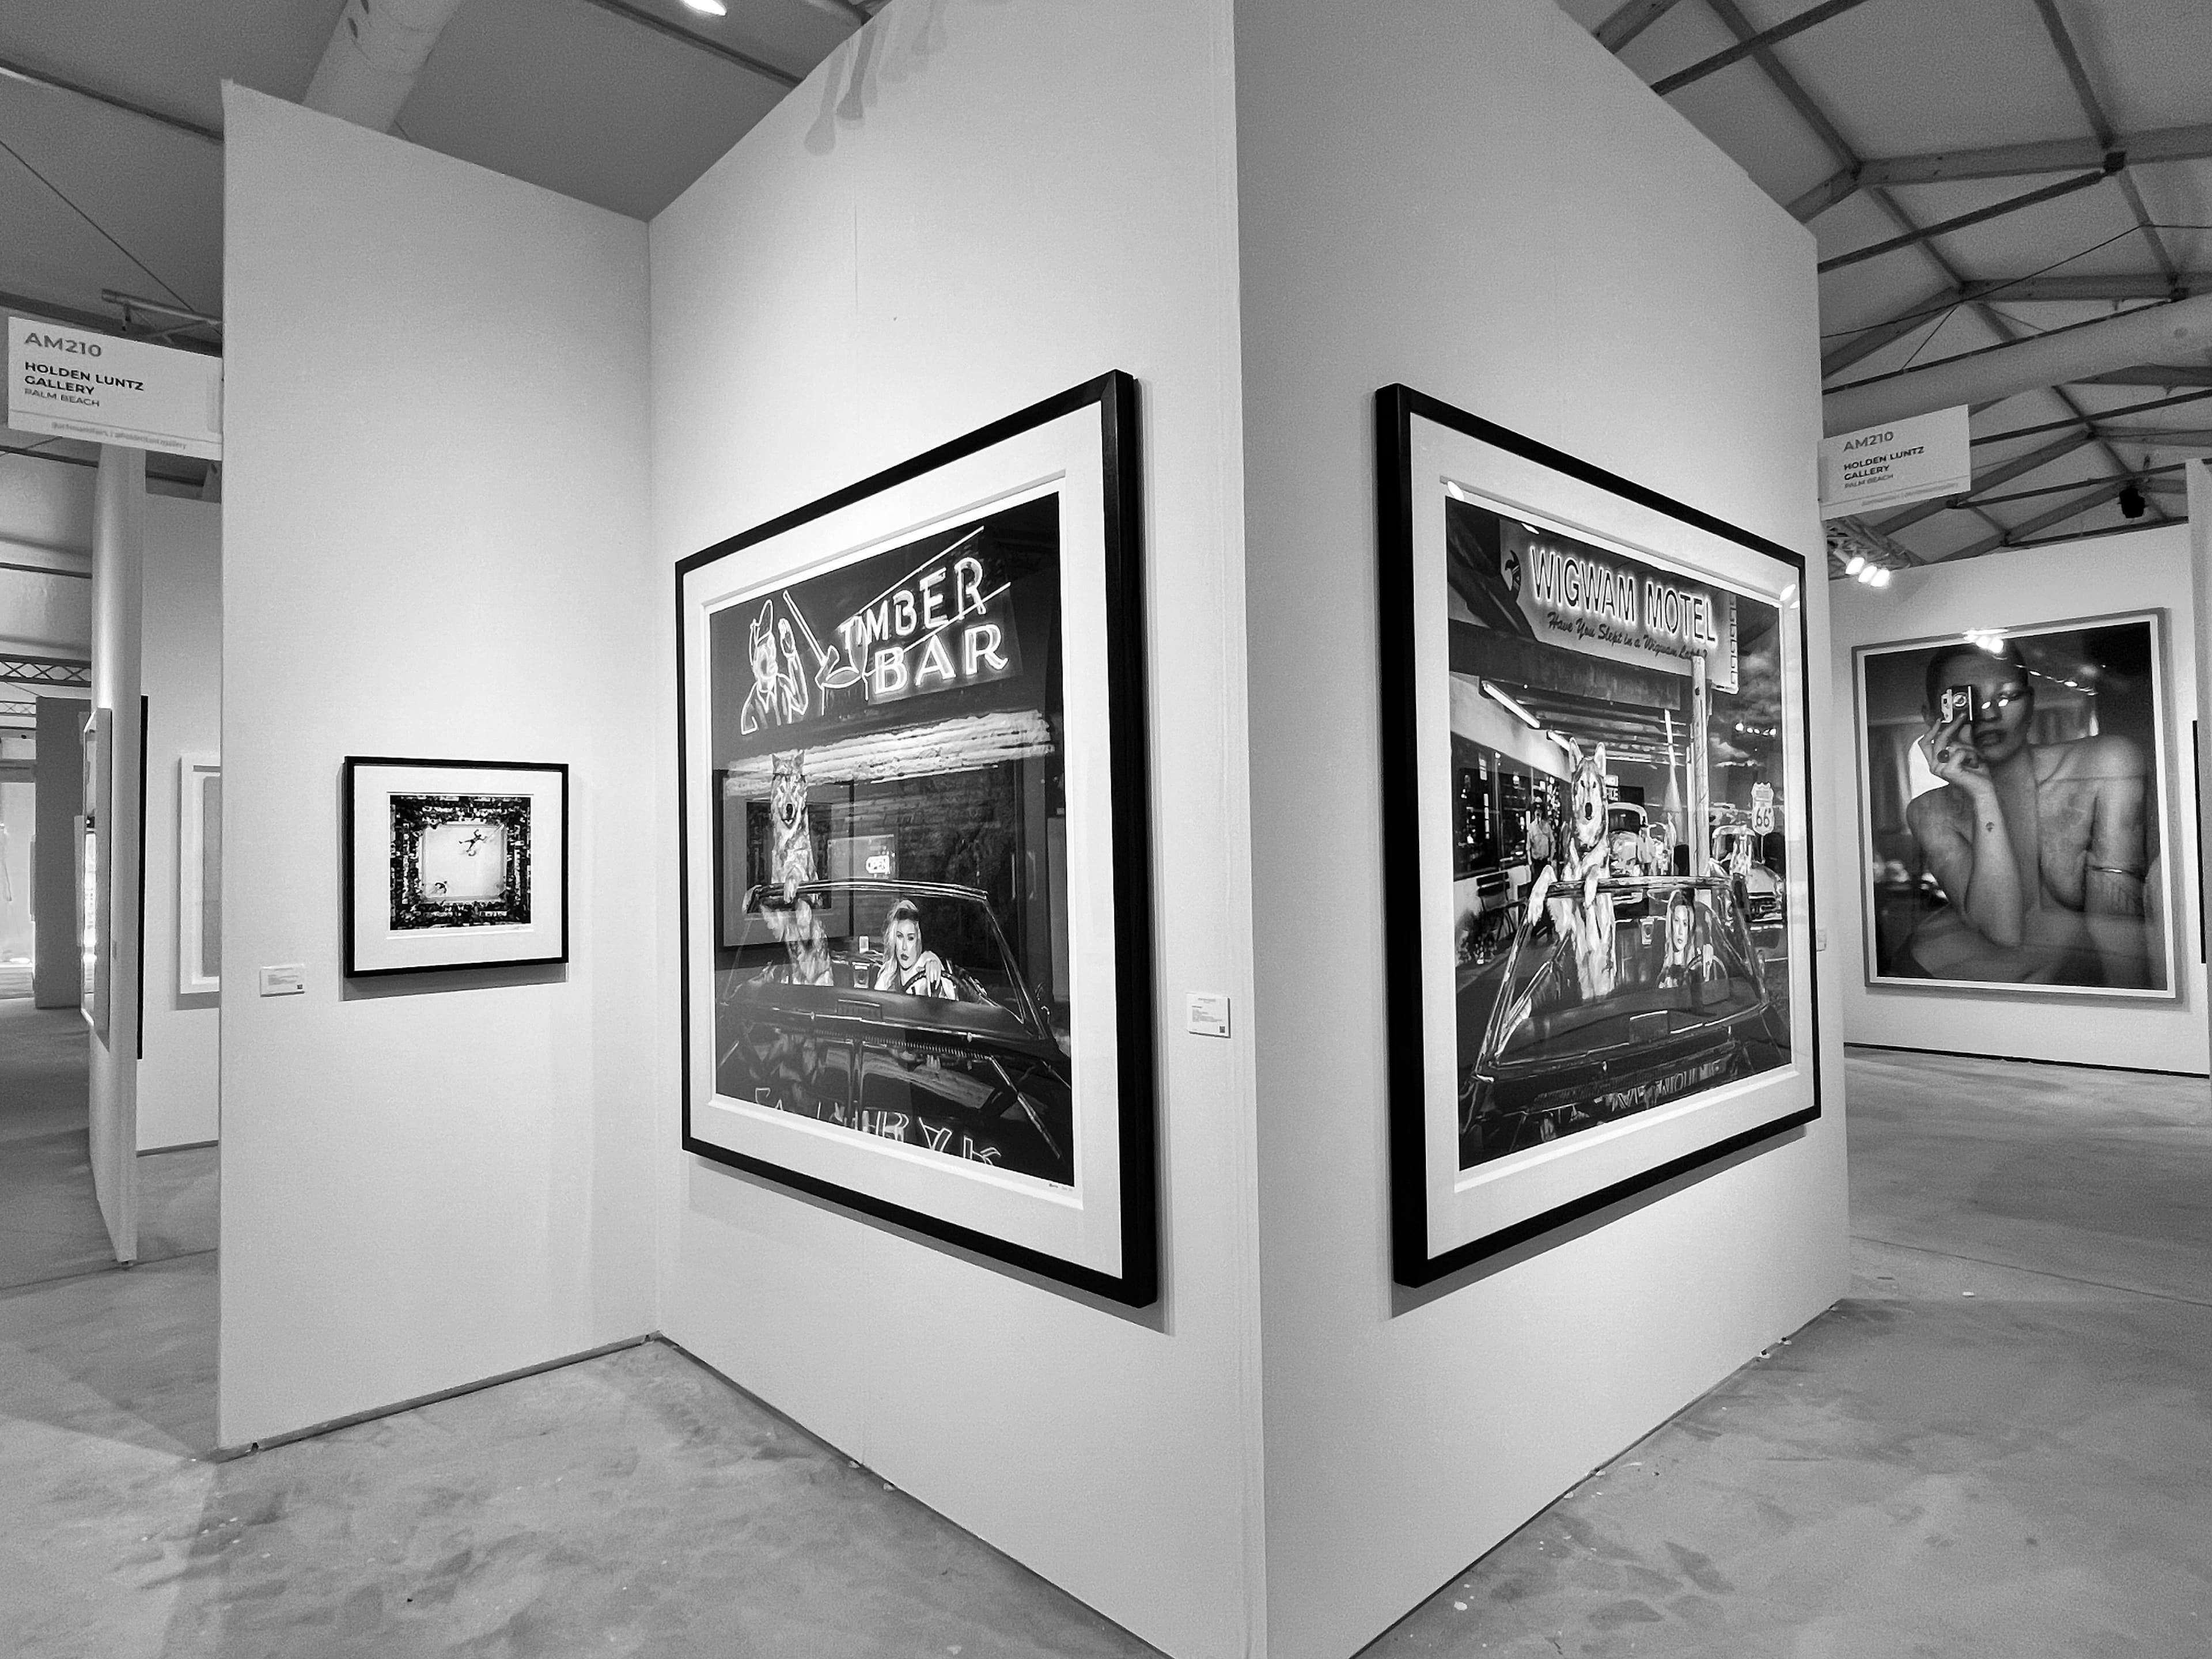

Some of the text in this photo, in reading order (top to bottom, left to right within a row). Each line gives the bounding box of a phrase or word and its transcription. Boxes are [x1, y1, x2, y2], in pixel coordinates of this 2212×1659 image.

[24, 332, 102, 357] AM210
[25, 361, 144, 391] HOLDEN LUNTZ
[25, 375, 94, 395] GALLERY
[24, 388, 100, 407] PALM BEACH
[1843, 431, 1894, 452] AM210
[1844, 446, 1925, 471] HOLDEN LUNTZ
[1844, 464, 1890, 480] GALLERY
[1844, 474, 1894, 488] PALM BEACH
[1529, 544, 1717, 644] WIGWAM MOTEL
[1547, 611, 1574, 632] Have
[1575, 618, 1596, 641] You
[1597, 623, 1623, 647] Slept
[874, 623, 1009, 694] BAR
[1756, 808, 1770, 828] 66
